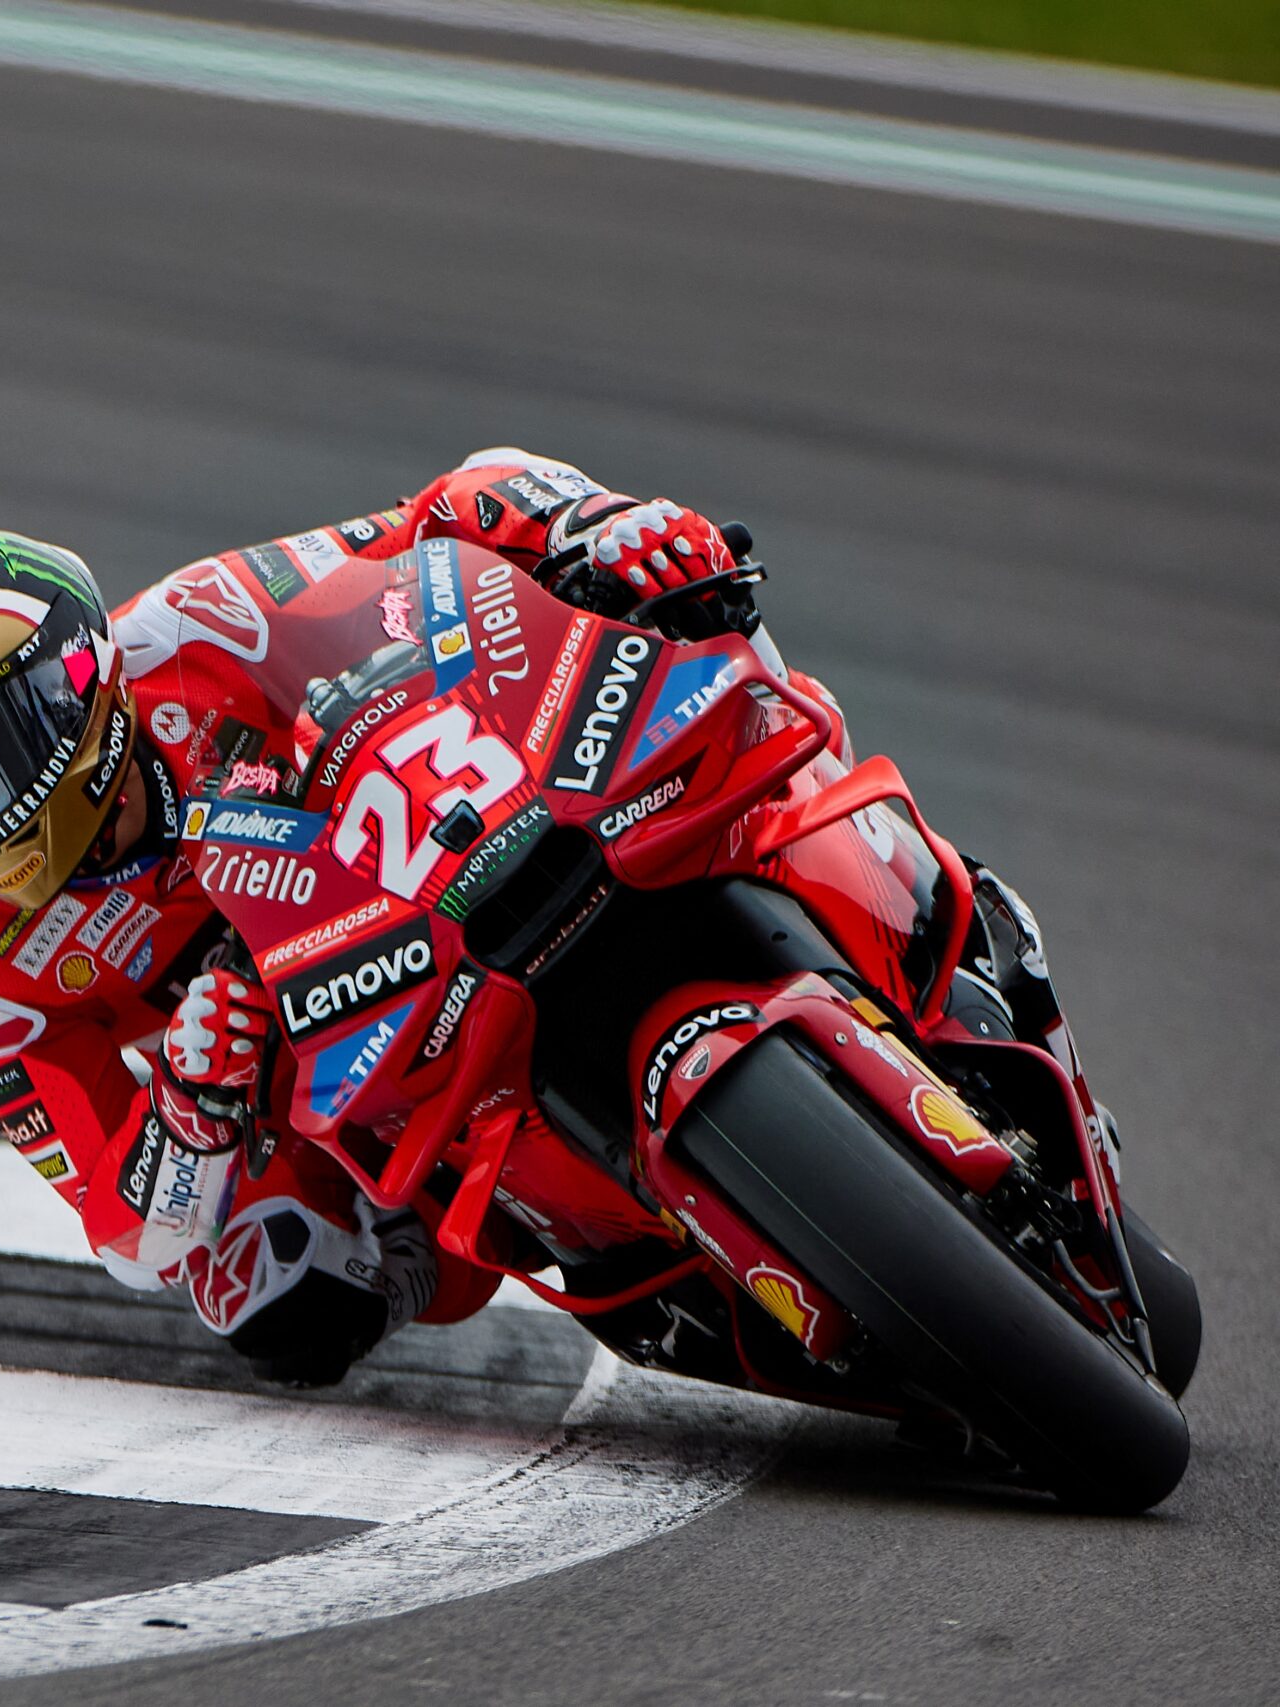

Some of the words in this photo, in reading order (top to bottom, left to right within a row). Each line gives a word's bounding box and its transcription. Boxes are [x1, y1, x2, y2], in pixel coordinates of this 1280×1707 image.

[526, 616, 590, 754] FRECCIAROSSA
[554, 635, 650, 792] Lenovo
[675, 667, 731, 721] TIM
[89, 711, 126, 797] Lenovo
[152, 760, 179, 839] Lenovo
[206, 811, 298, 843] ADVANCE
[332, 704, 524, 900] 23
[599, 776, 685, 838] CARRERA
[102, 863, 141, 885] TIM
[263, 897, 390, 970] FRECCIAROSSA
[282, 939, 431, 1033] Lenovo
[424, 973, 476, 1058] CARRERA
[349, 1021, 395, 1078] TIM
[643, 1006, 751, 1121] Lenovo
[122, 1117, 160, 1208] Lenovo
